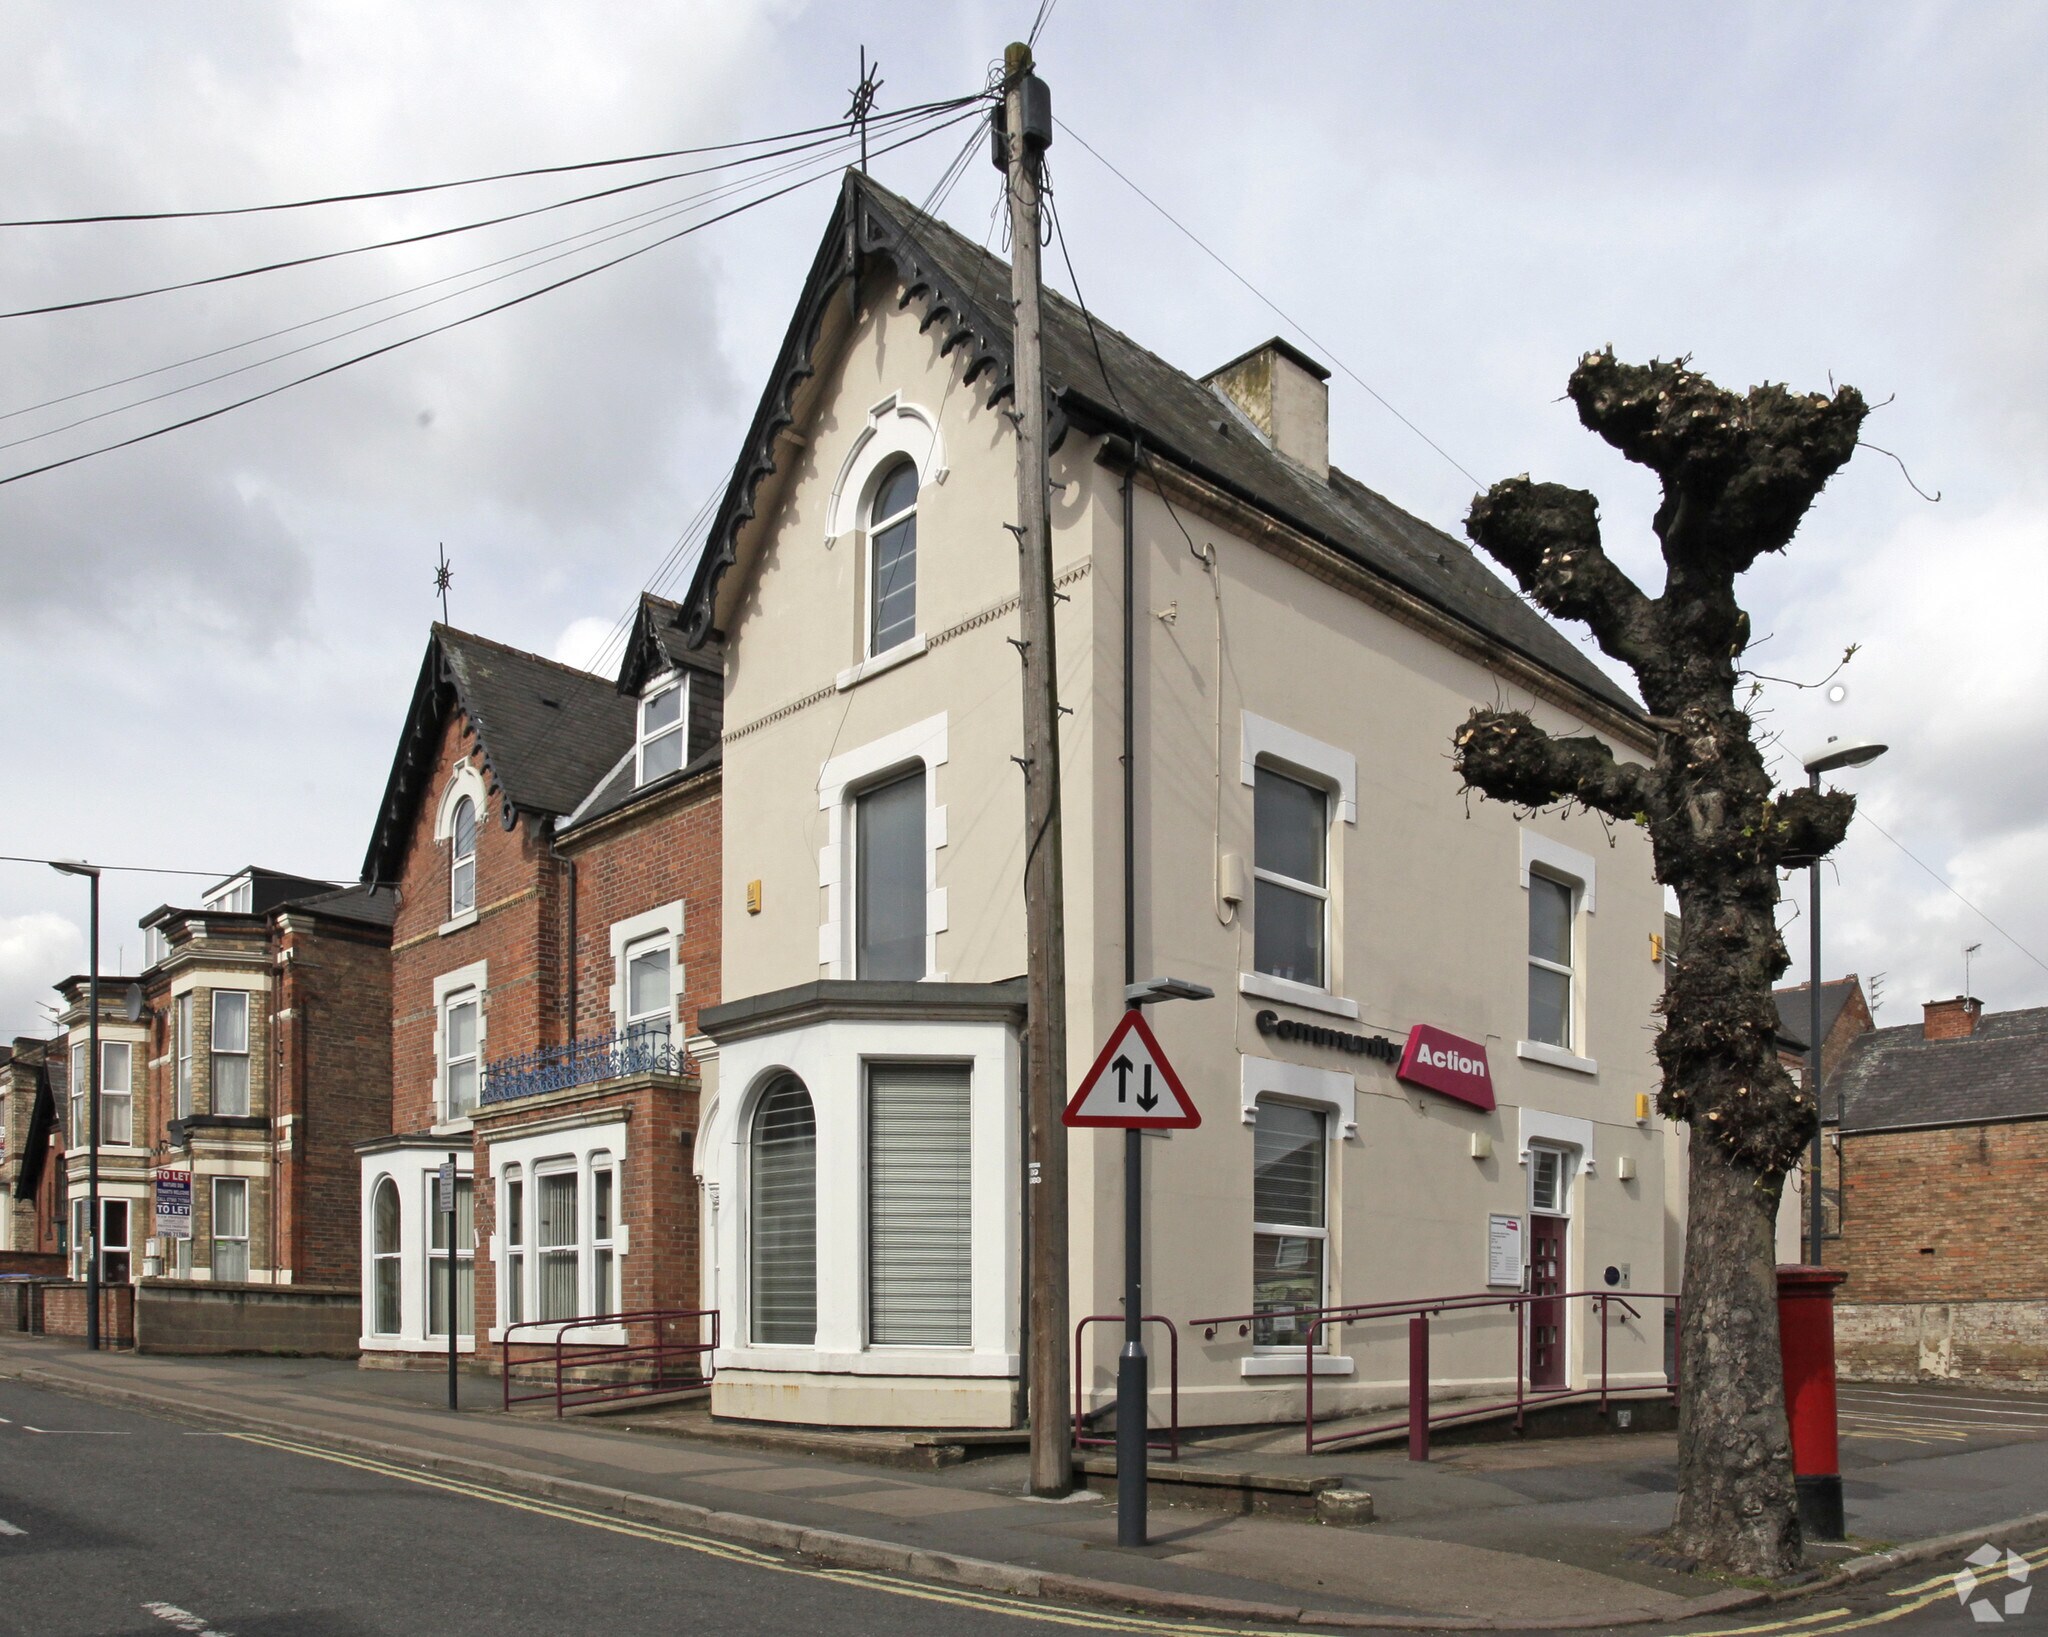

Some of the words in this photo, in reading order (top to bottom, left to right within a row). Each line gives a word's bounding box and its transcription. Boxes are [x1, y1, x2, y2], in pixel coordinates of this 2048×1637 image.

[1256, 1010, 1403, 1063] Community
[1417, 1043, 1485, 1077] Action
[157, 1170, 170, 1180] TO
[172, 1172, 190, 1181] LET
[157, 1204, 170, 1214] TO
[172, 1205, 189, 1214] LET
